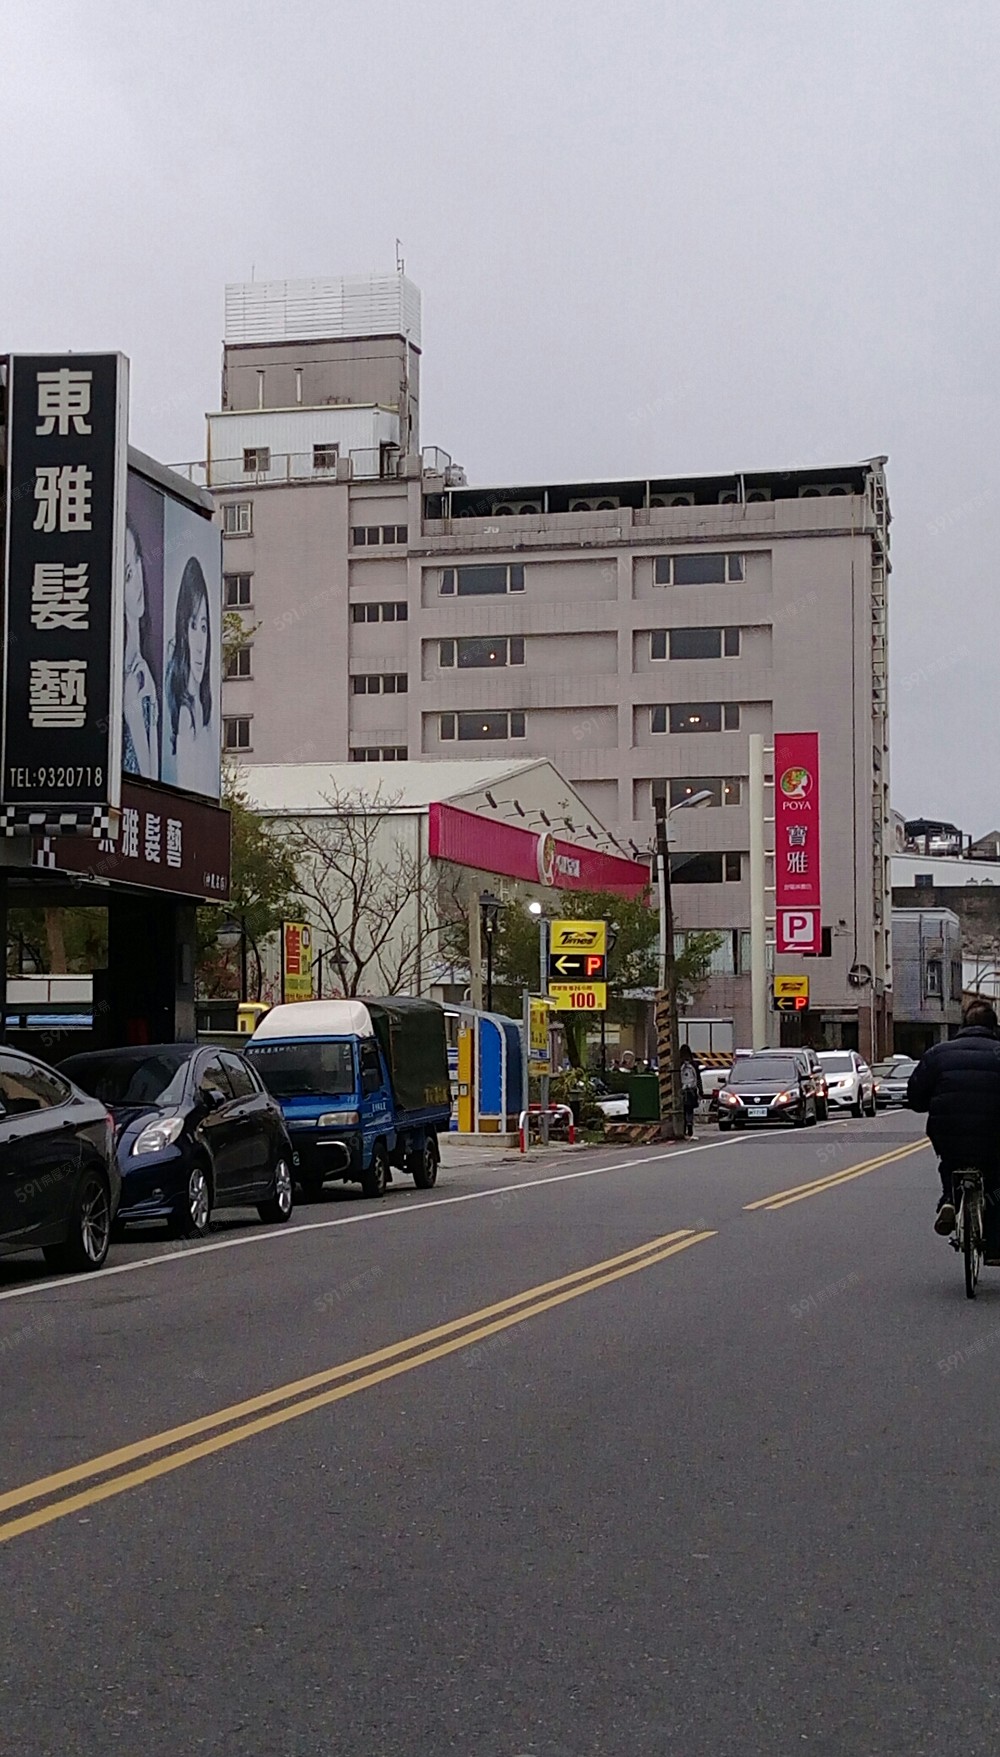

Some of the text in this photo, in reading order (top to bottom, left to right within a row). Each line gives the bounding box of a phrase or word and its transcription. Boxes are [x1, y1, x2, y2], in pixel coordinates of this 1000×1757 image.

[29, 368, 93, 728] 東雅髮藝
[10, 767, 103, 787] TEL:9320718
[782, 801, 811, 811] POYA
[786, 824, 808, 874] 寶雅
[789, 916, 807, 938] P
[560, 931, 598, 945] Times
[587, 957, 601, 975] P
[569, 992, 596, 1008] 100
